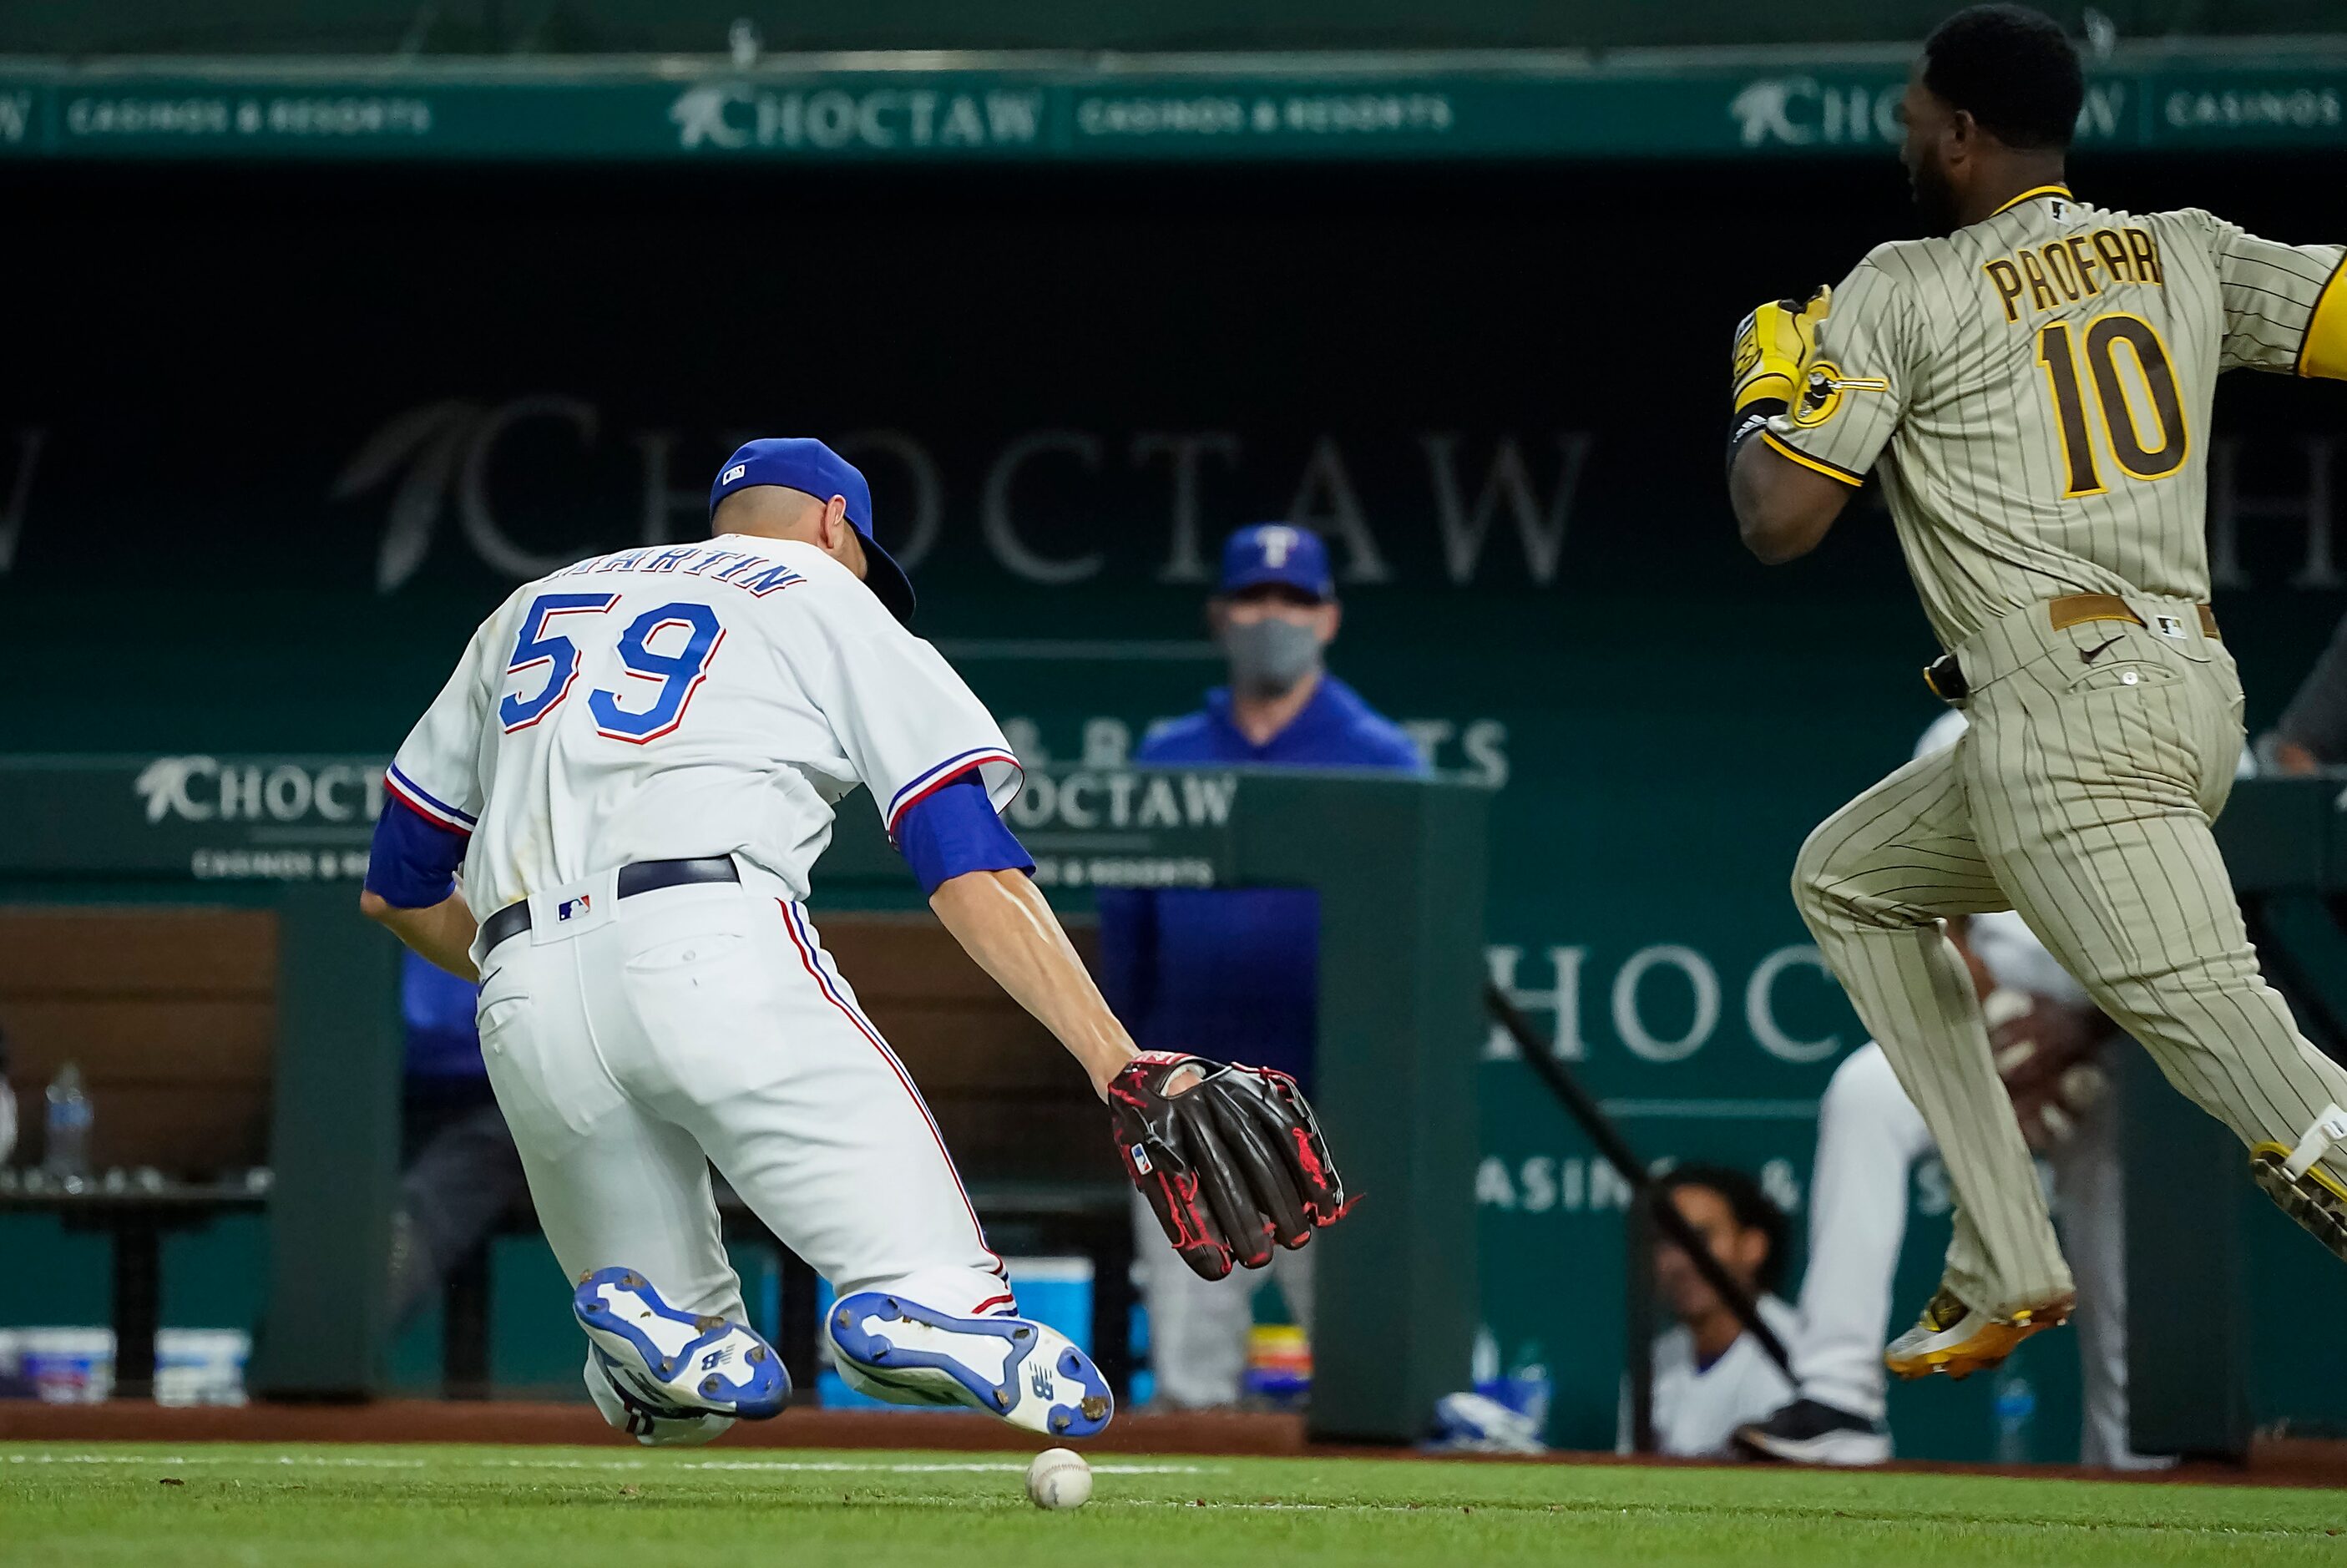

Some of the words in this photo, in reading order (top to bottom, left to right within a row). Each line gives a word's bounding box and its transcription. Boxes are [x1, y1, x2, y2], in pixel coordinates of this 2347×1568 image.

[710, 85, 1042, 149] CHOCTAW
[1982, 228, 2162, 323] PROFAR
[2036, 311, 2191, 499] 10
[498, 593, 727, 745] 59
[1009, 771, 1237, 828] OCTAW
